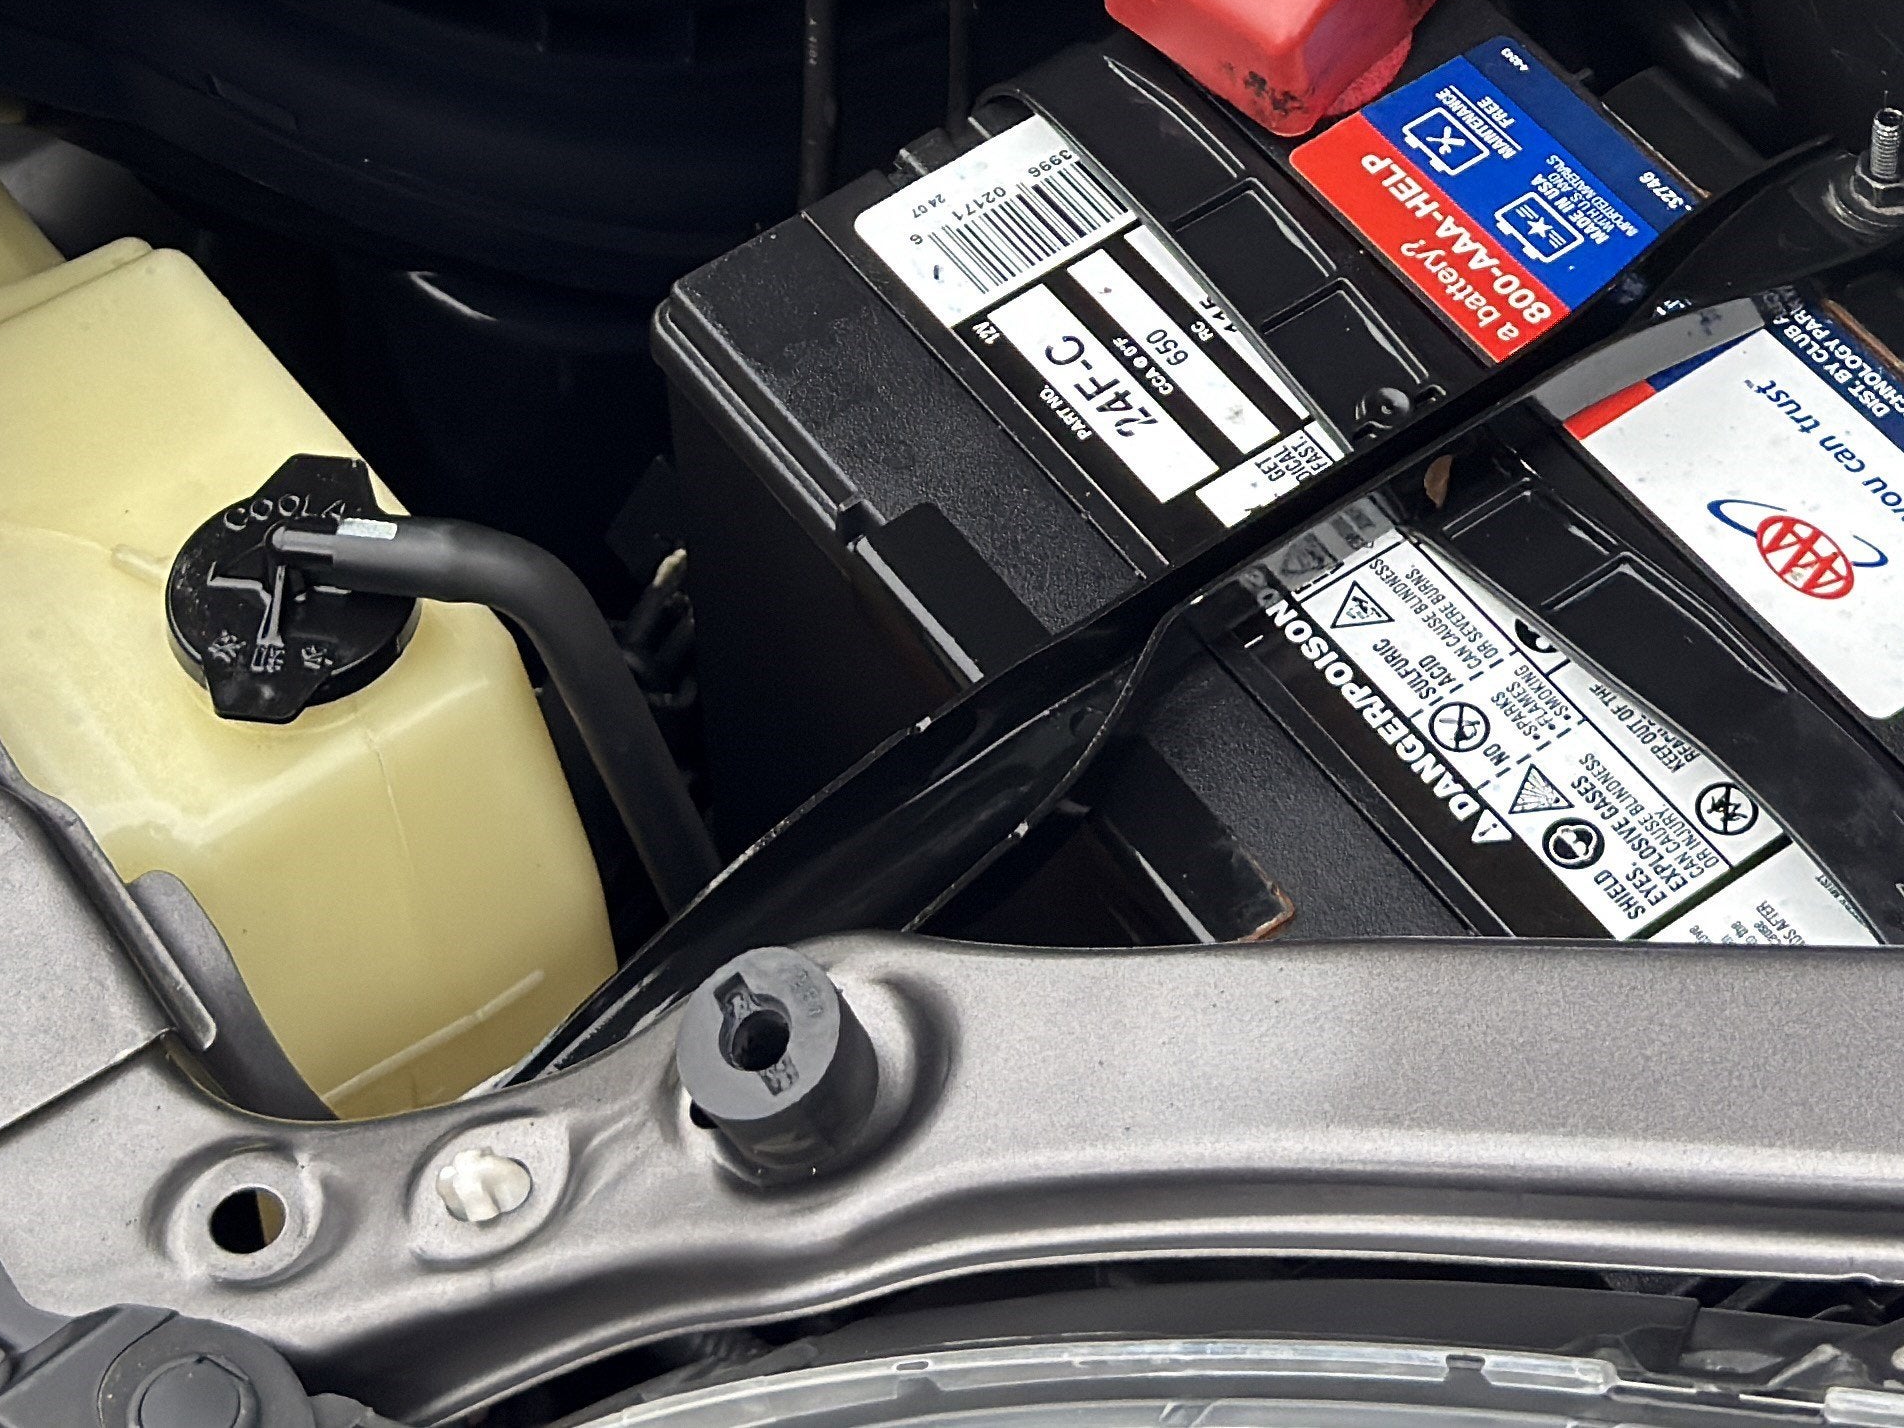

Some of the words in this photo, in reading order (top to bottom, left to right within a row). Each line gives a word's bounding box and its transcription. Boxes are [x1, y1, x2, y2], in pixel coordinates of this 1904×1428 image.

[1434, 86, 1520, 159] MAINTENANCE
[1475, 95, 1515, 129] FREE
[1026, 147, 1073, 180] 3996
[1544, 153, 1597, 199] MATERIALS
[1546, 171, 1577, 192] AND
[951, 185, 1008, 223] 02171
[1530, 172, 1564, 205] USA
[1555, 195, 1575, 213] IN
[1568, 189, 1594, 211] U.S.
[1638, 170, 1684, 209] 32746
[1567, 208, 1610, 244] MADE
[1585, 205, 1616, 233] WITH
[1589, 194, 1638, 237] IMPORTED
[908, 230, 925, 247] 6
[1360, 153, 1552, 324] 800-AAA-HELP
[1399, 238, 1501, 328] battery?
[971, 320, 1000, 344] 12V
[1144, 328, 1189, 366] 650
[1189, 319, 1214, 342] RC
[1495, 320, 1519, 341] a
[1782, 323, 1829, 363] CLUB
[1043, 334, 1159, 437] 24F-C
[1144, 365, 1174, 395] CCA
[1822, 361, 1853, 384] BY
[1038, 383, 1064, 409] NO.
[1846, 378, 1891, 418] DIST.
[1054, 405, 1093, 440] PART
[1253, 455, 1286, 482] GET
[1271, 442, 1312, 484] DICAL
[1289, 434, 1328, 472] FAST.
[1817, 433, 1866, 473] can
[223, 494, 346, 531] COOLA
[1760, 520, 1852, 597] AAA
[1367, 554, 1429, 617] BLINDNESS
[1403, 563, 1446, 606] BURNS.
[1420, 609, 1461, 648] CAUSE
[1437, 600, 1484, 643] SEVERE
[1452, 643, 1483, 670] CAN
[1475, 638, 1499, 659] OR
[1371, 637, 1437, 700] SULFURIC
[1417, 653, 1457, 687] ACID
[1264, 597, 1481, 821] DANGER/POISON
[1504, 680, 1554, 727] FLAMES
[1512, 663, 1569, 717] SMOKING
[1489, 690, 1539, 737] SPARKS
[1609, 703, 1635, 722] OF
[1624, 717, 1658, 745] OUT
[1481, 742, 1511, 767] NO
[1649, 743, 1686, 773] KEEP
[1569, 774, 1620, 820] GASES
[1577, 751, 1645, 817] BLINDNESS
[1636, 811, 1681, 854] CAUSE
[1652, 806, 1702, 851] INJURY.
[1609, 815, 1689, 893] EXPLOSIVE
[1673, 850, 1705, 879] CAN
[1694, 846, 1720, 869] OR
[1592, 868, 1647, 920] SHIELD
[1624, 860, 1668, 906] EYES.
[1729, 919, 1749, 939] the
[1754, 899, 1790, 932] AFTER
